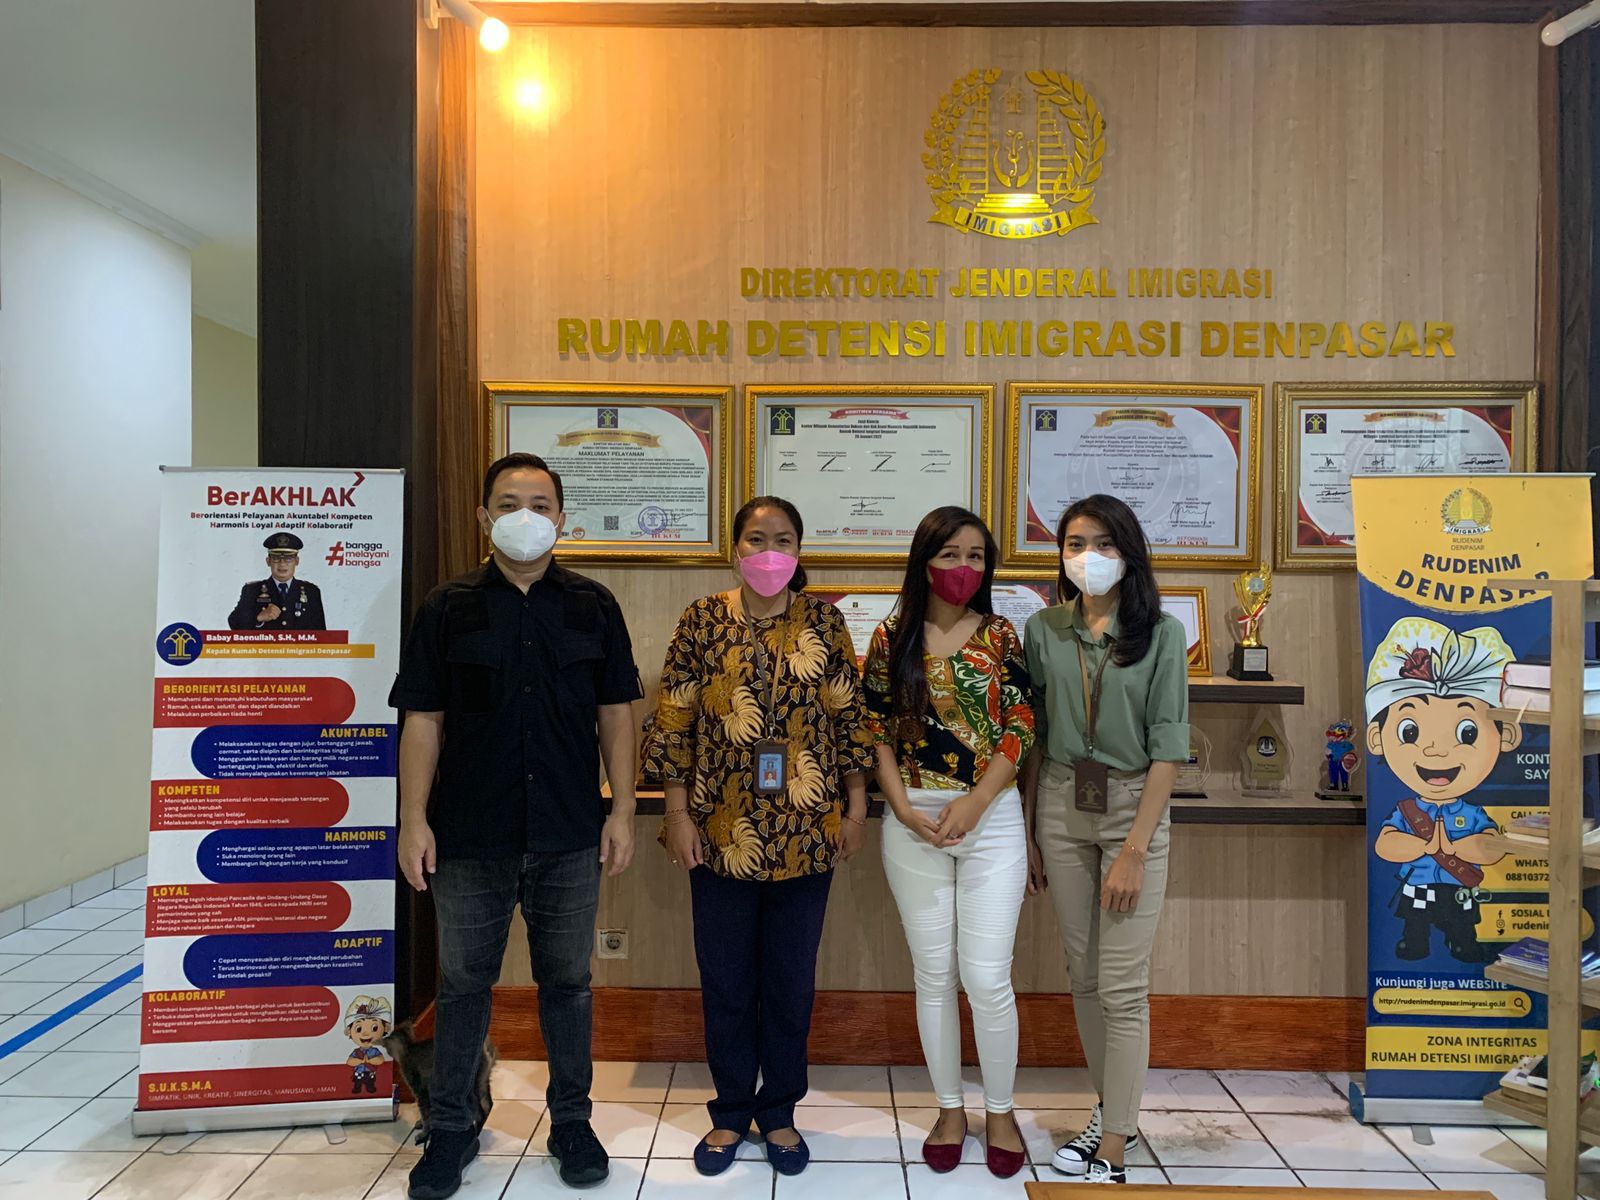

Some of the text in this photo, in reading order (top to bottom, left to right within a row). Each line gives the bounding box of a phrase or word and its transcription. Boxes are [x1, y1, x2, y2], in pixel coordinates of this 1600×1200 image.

[966, 212, 1061, 235] IMIGRASI
[741, 267, 1273, 299] DIREKTORAT JENDERAL IMIGRASI
[557, 318, 1456, 358] RUMAH DETENSI IMIGRASI DENPASAR
[207, 486, 357, 507] BerAKHLAK
[242, 513, 284, 521] Pelayanan
[330, 513, 373, 521] Kompeten
[251, 522, 273, 530] Loyal
[274, 522, 305, 530] Adaptif
[345, 541, 382, 551] bangga
[345, 550, 390, 559] melayani
[345, 559, 381, 568] bangsa
[1422, 554, 1522, 574] RUDENIM
[206, 634, 232, 642] Babay
[163, 685, 306, 694] BERORIENTASI PELAYANAN
[320, 728, 388, 738] AKUNTABEL
[1517, 753, 1550, 764] KONT
[158, 785, 220, 796] KOMPETEN
[325, 831, 386, 842] HARMONIS
[1515, 859, 1549, 867] WHATS
[1505, 873, 1550, 881] 08810372
[153, 886, 190, 897] LOYAL
[1511, 909, 1544, 917] SOSIAL
[333, 937, 383, 949] ADAPTIF
[1375, 976, 1426, 990] Kunjungi
[1429, 978, 1455, 990] juga
[149, 990, 226, 1002] KOLABORATIF
[1427, 1036, 1537, 1047] ZONA INTEGRITAS
[1371, 1052, 1528, 1065] RUMAH DETENSI IMIGRA
[148, 1080, 212, 1093] S.U.K.S.M.A
